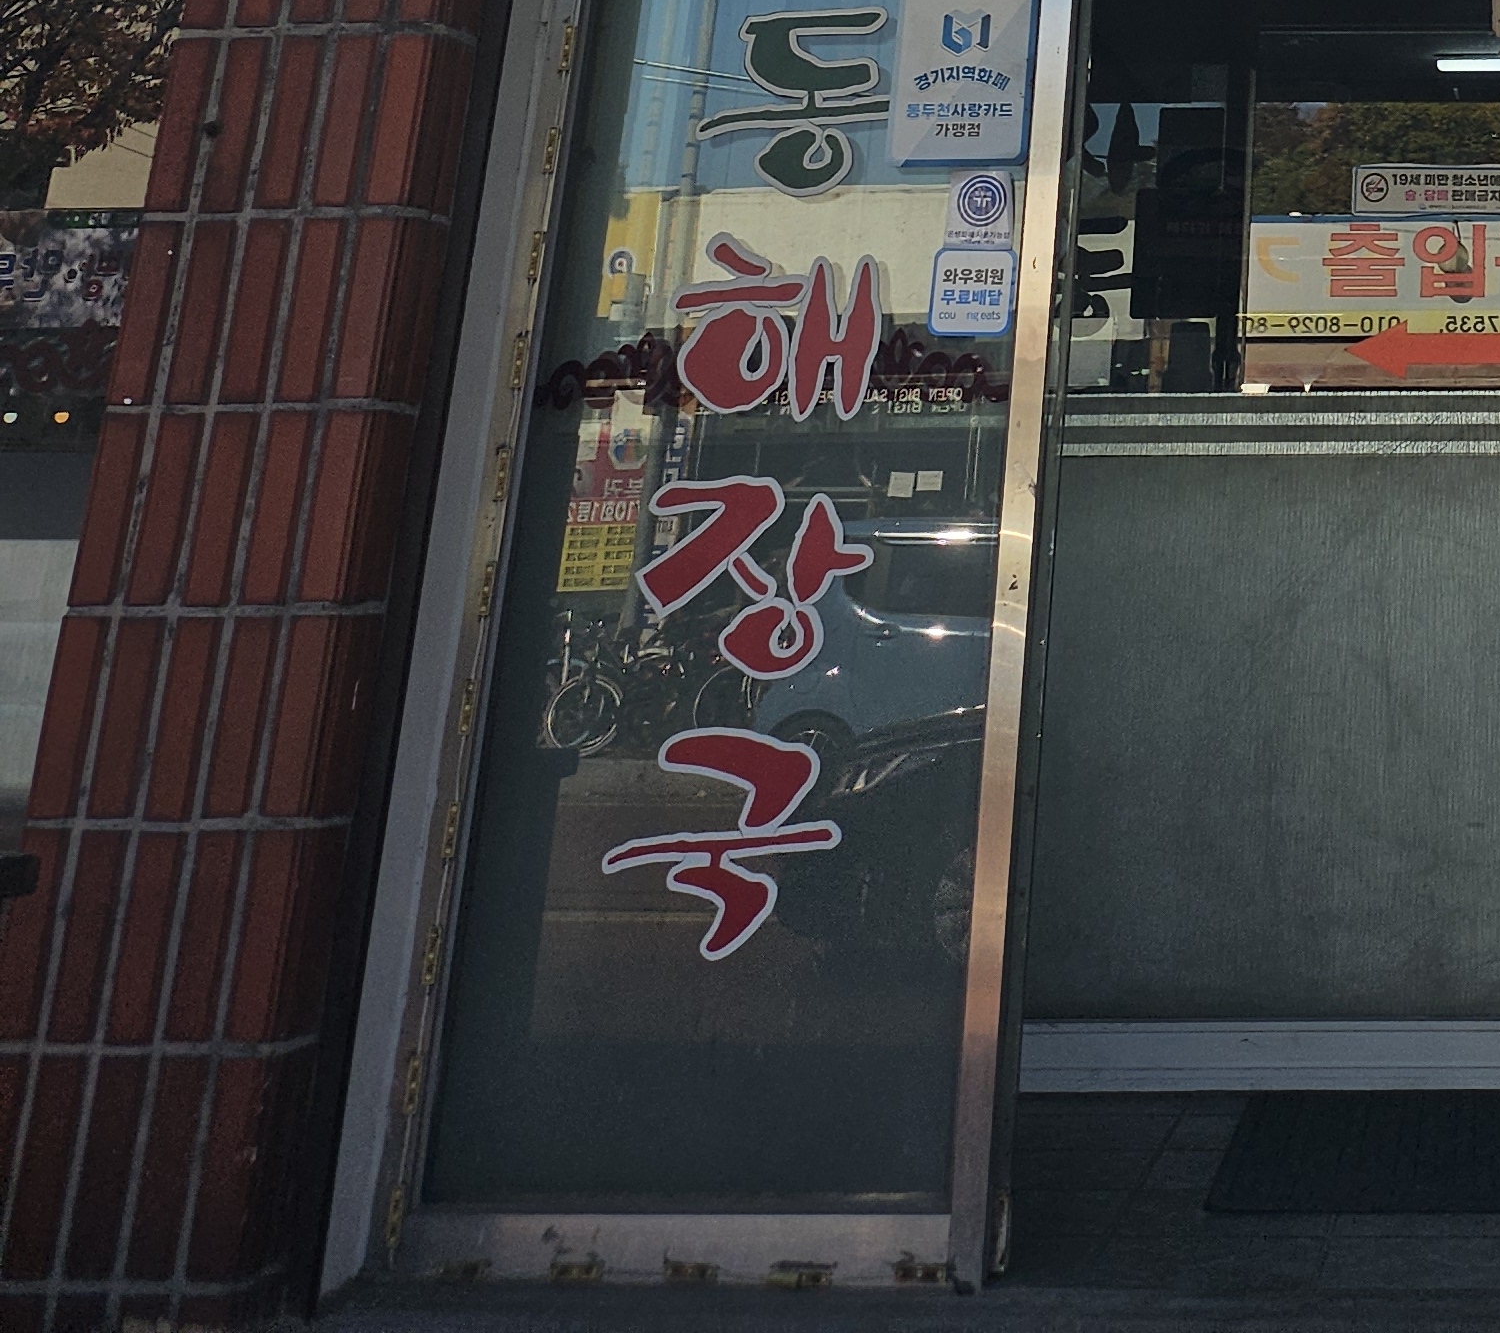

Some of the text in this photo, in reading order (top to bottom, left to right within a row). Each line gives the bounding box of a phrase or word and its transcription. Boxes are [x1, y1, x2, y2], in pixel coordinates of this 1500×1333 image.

[914, 66, 1011, 91] 경기지역화폐
[907, 103, 1013, 118] 동두천사랑카드
[935, 122, 981, 137] 가맹점
[942, 268, 1005, 285] 와우회원
[940, 289, 1003, 306] 무료배달
